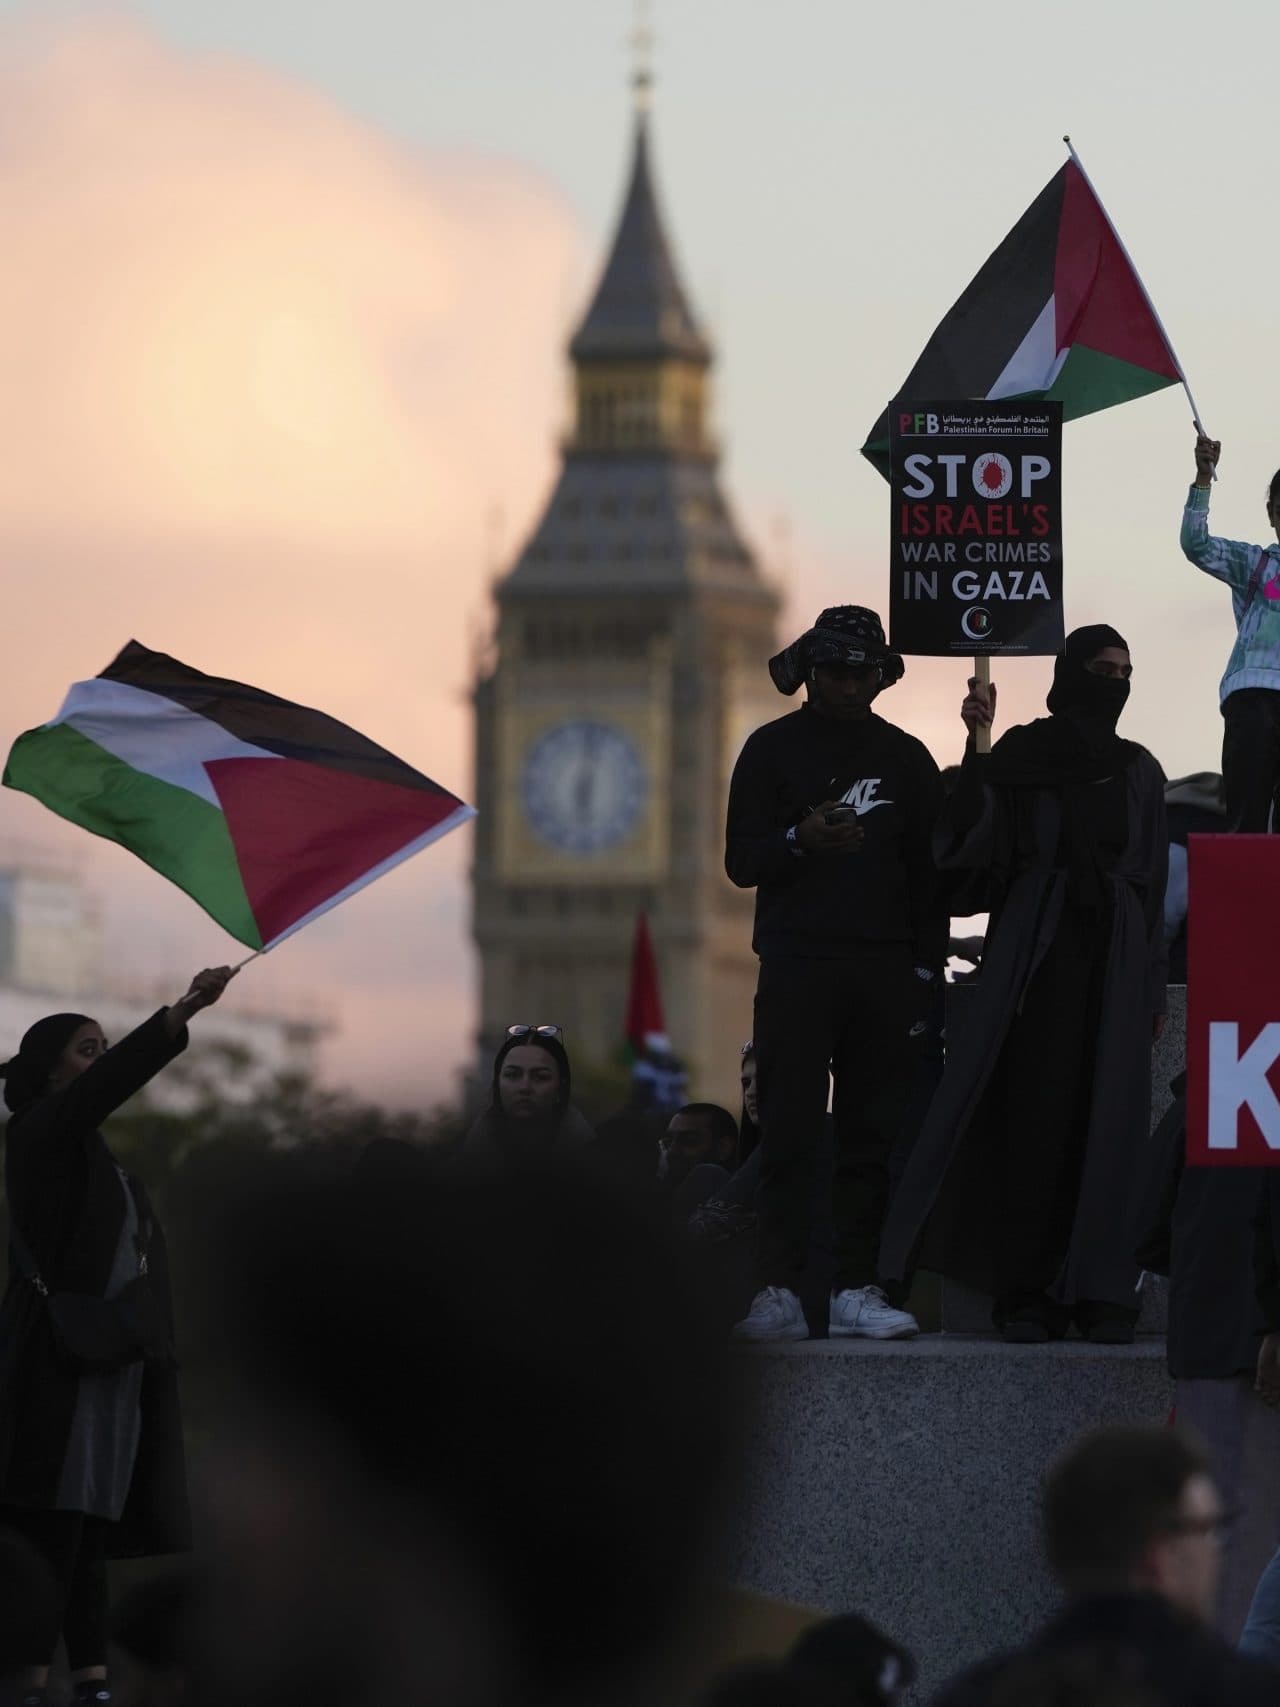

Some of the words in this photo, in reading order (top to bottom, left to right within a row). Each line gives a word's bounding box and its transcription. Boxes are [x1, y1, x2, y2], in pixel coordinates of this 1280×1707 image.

[899, 413, 939, 434] PFB
[943, 425, 988, 434] Palestinian
[988, 425, 1012, 434] Forum
[1023, 425, 1050, 435] Britain
[902, 452, 1051, 499] STOP
[901, 503, 1050, 537] ISRAEL'S
[901, 541, 956, 563] WAR
[965, 541, 1052, 563] CRIMES
[903, 570, 938, 600] IN
[951, 569, 1052, 601] GAZA
[841, 778, 882, 807] IKE
